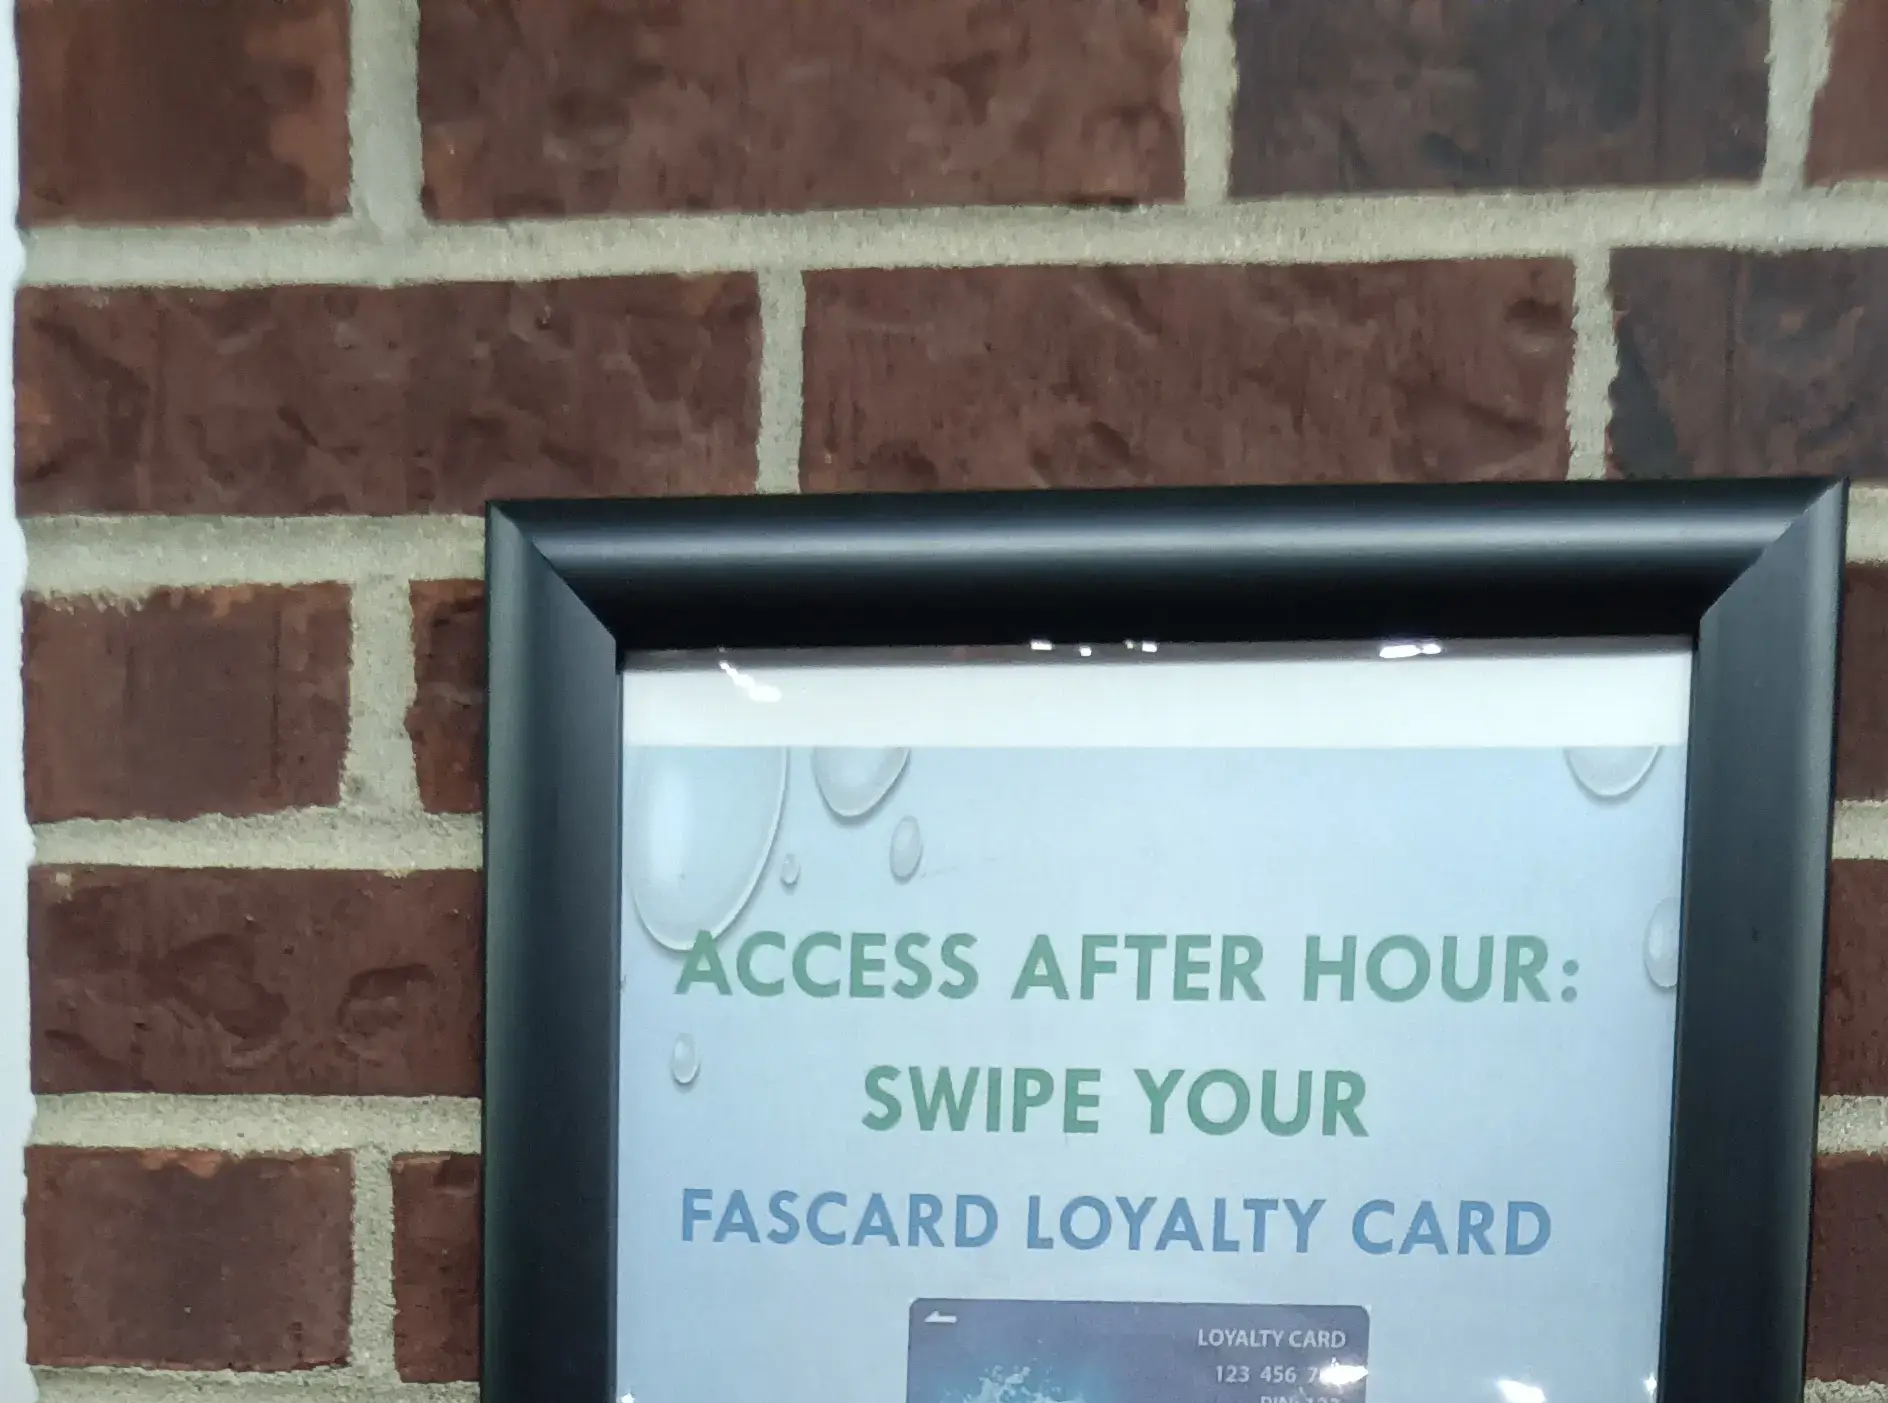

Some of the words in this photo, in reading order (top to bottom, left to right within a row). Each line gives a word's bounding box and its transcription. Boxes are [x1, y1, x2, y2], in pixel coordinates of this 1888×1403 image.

[674, 929, 978, 998] ACCESS
[1011, 934, 1267, 1001] AFTER
[1302, 935, 1580, 1004] HOUR:
[862, 1065, 1102, 1134] SWIPE
[1134, 1068, 1369, 1138] YOUR
[681, 1187, 998, 1249] FASCARD
[1025, 1193, 1326, 1253] LOYALTY
[1351, 1200, 1552, 1257] CARD
[1198, 1328, 1284, 1348] LOYALTY
[1288, 1330, 1347, 1349] CARD
[1216, 1365, 1250, 1383] 123
[1260, 1365, 1297, 1383] 456
